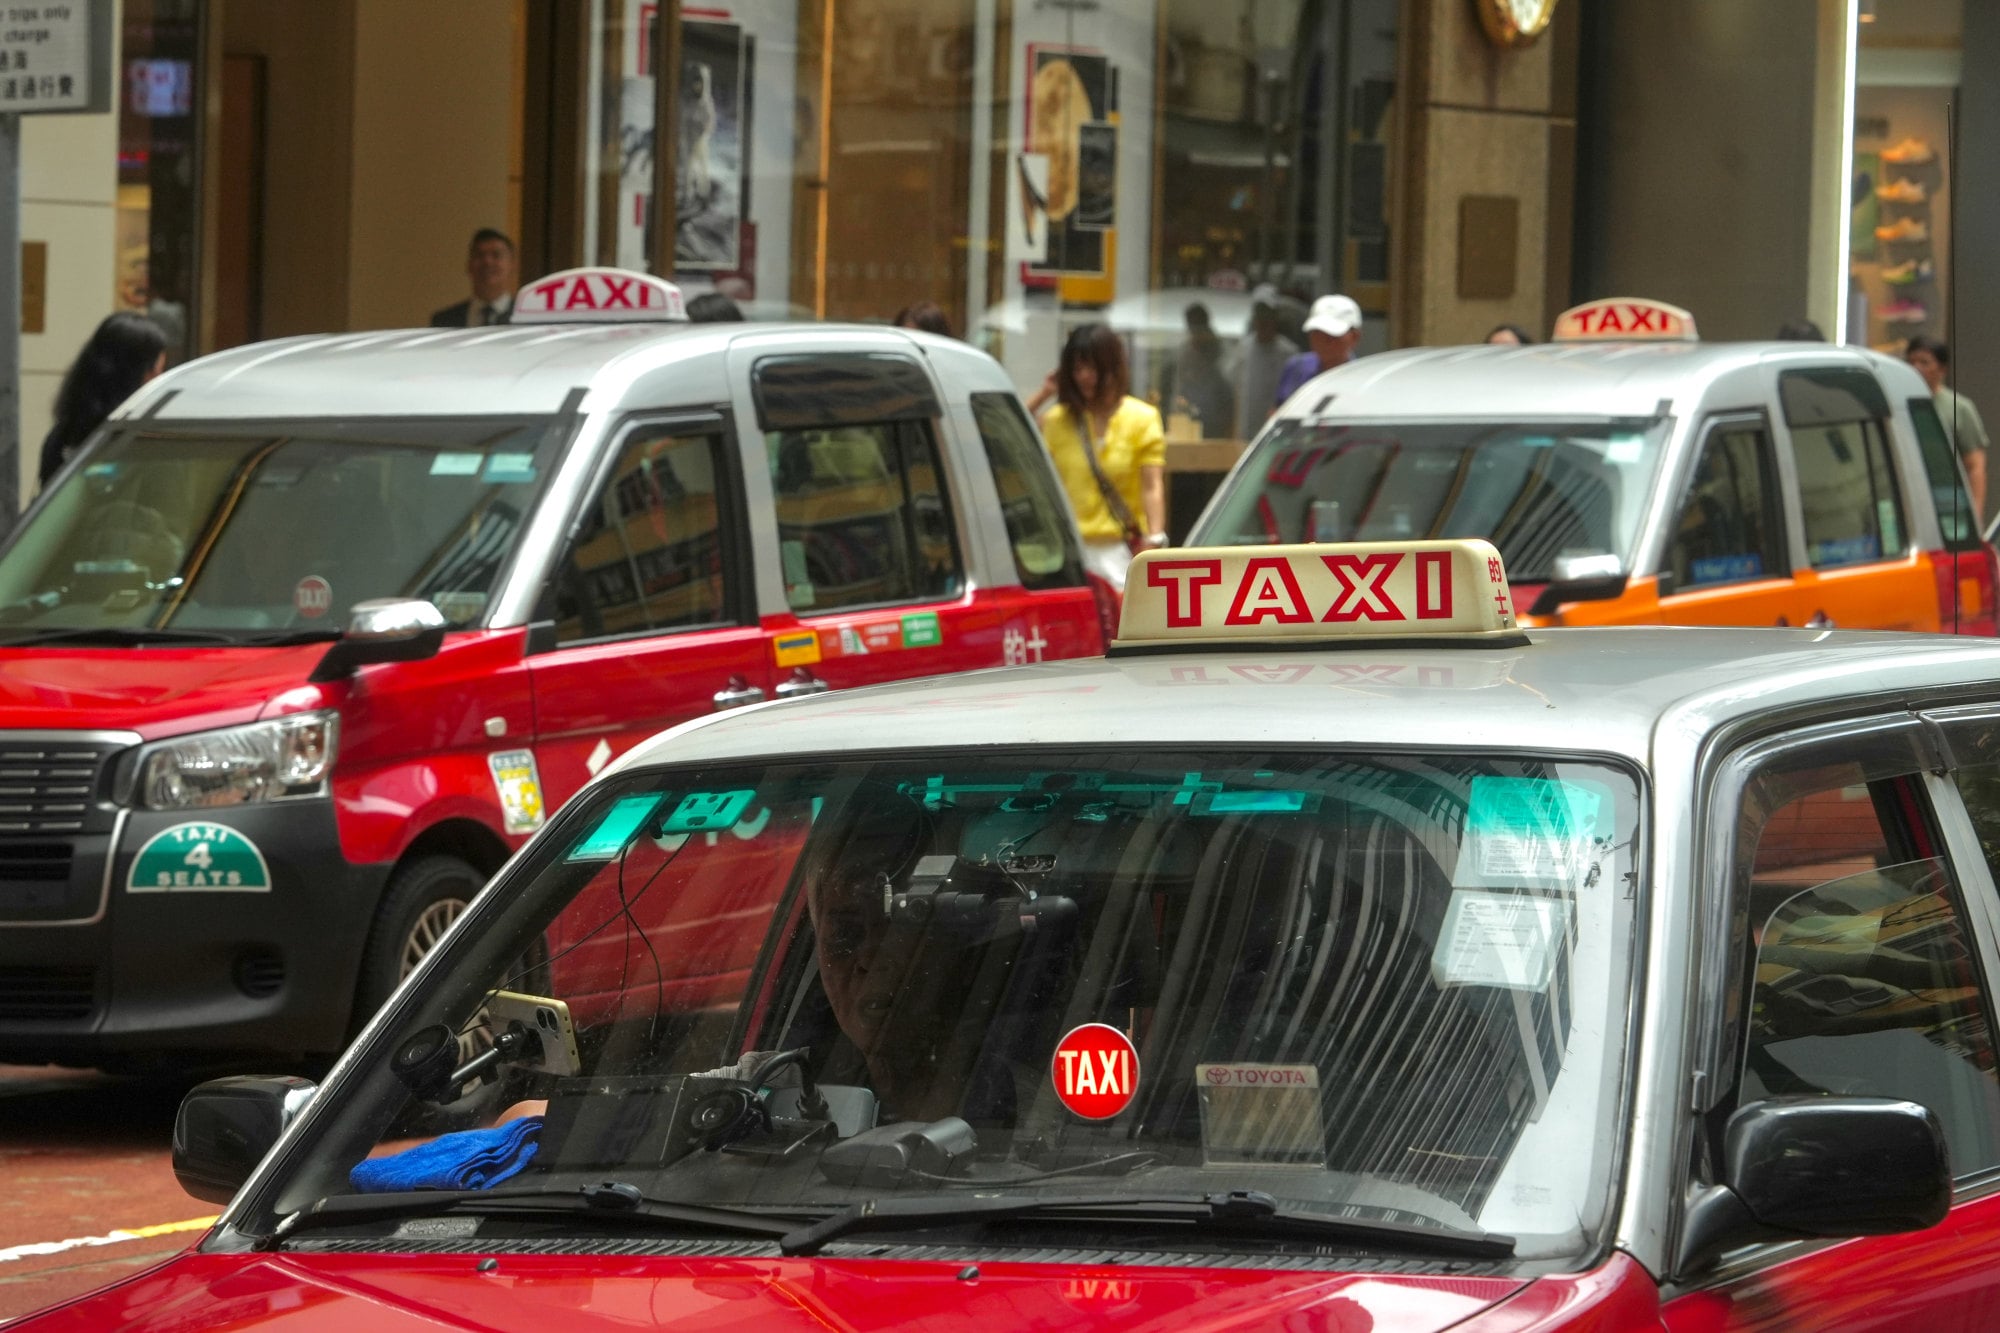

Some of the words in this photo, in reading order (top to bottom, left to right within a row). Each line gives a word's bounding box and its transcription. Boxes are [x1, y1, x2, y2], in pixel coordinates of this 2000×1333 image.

[43, 5, 72, 21] only
[5, 31, 50, 45] charge
[535, 276, 649, 311] TAXI
[1573, 305, 1668, 333] TAXI
[297, 587, 328, 608] TAXI
[1147, 551, 1453, 628] TAXI
[1488, 557, 1508, 614] 的士
[171, 827, 228, 843] TAXI
[184, 842, 213, 869] 4
[157, 871, 242, 886] SEATS
[1059, 1050, 1129, 1095] TAXI
[1234, 1069, 1306, 1085] TOYOTA
